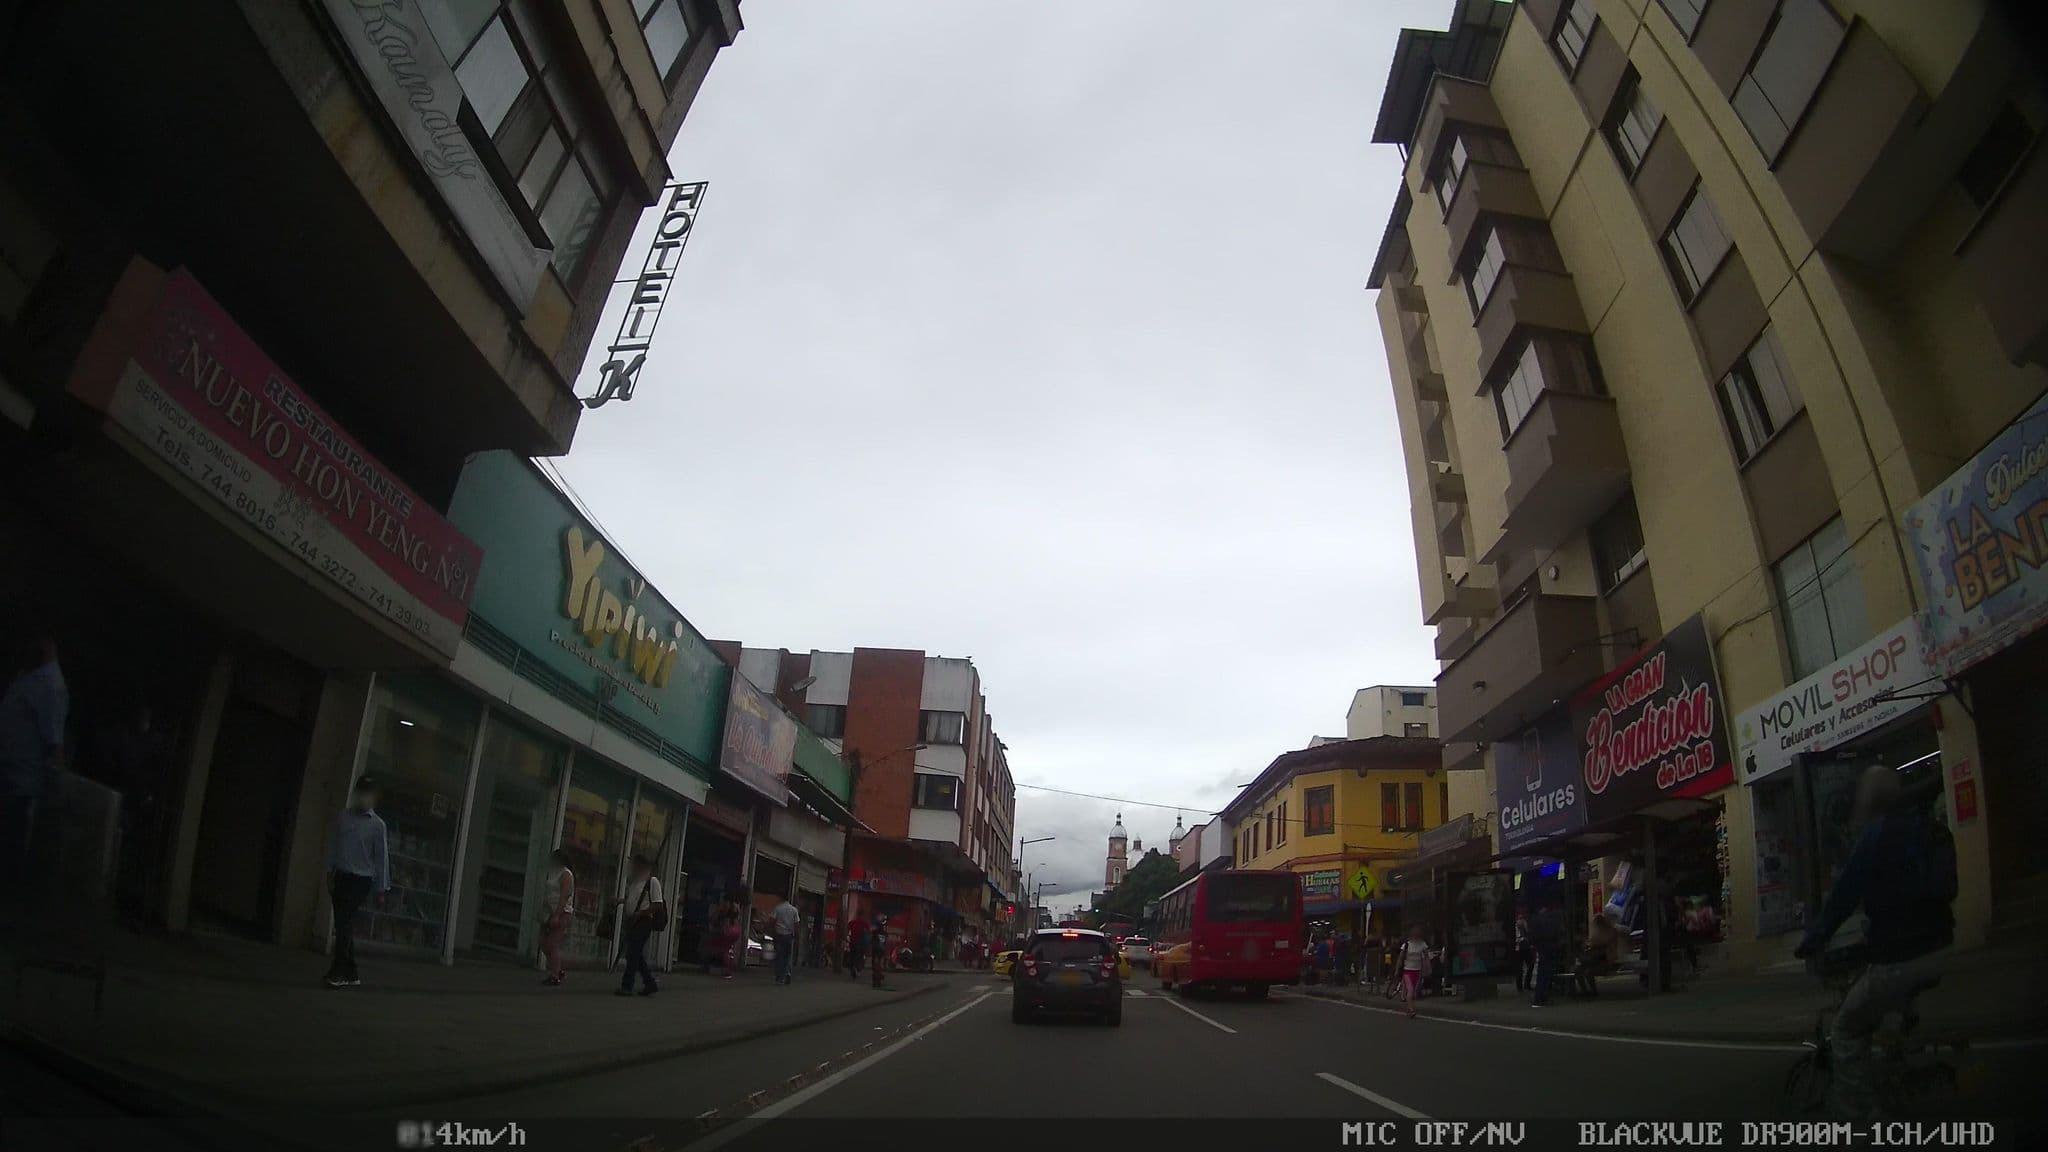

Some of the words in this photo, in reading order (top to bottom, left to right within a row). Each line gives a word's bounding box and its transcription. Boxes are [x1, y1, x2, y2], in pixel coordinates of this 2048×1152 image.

[608, 185, 701, 352] HOTEL
[177, 340, 291, 460] NUEVO
[291, 442, 361, 521] HON
[366, 499, 433, 577] YENG
[263, 374, 414, 519] RESTAURANTE
[1985, 437, 2048, 511] Dulce
[157, 425, 193, 471] Tels.
[201, 463, 235, 500] 744
[291, 531, 319, 563] 744
[320, 548, 357, 590] 3272
[367, 585, 393, 613] 741
[1947, 503, 1993, 551] LA
[1605, 684, 1625, 716] LA
[1623, 651, 1666, 710] GRAN
[1760, 684, 1833, 739] MOVIL
[1831, 635, 1907, 703] SHOP
[1584, 683, 1714, 795] Bendición
[1656, 760, 1675, 790] de
[1674, 750, 1697, 782] La
[1781, 720, 1826, 751] Celulares
[1502, 784, 1575, 829] Celulares
